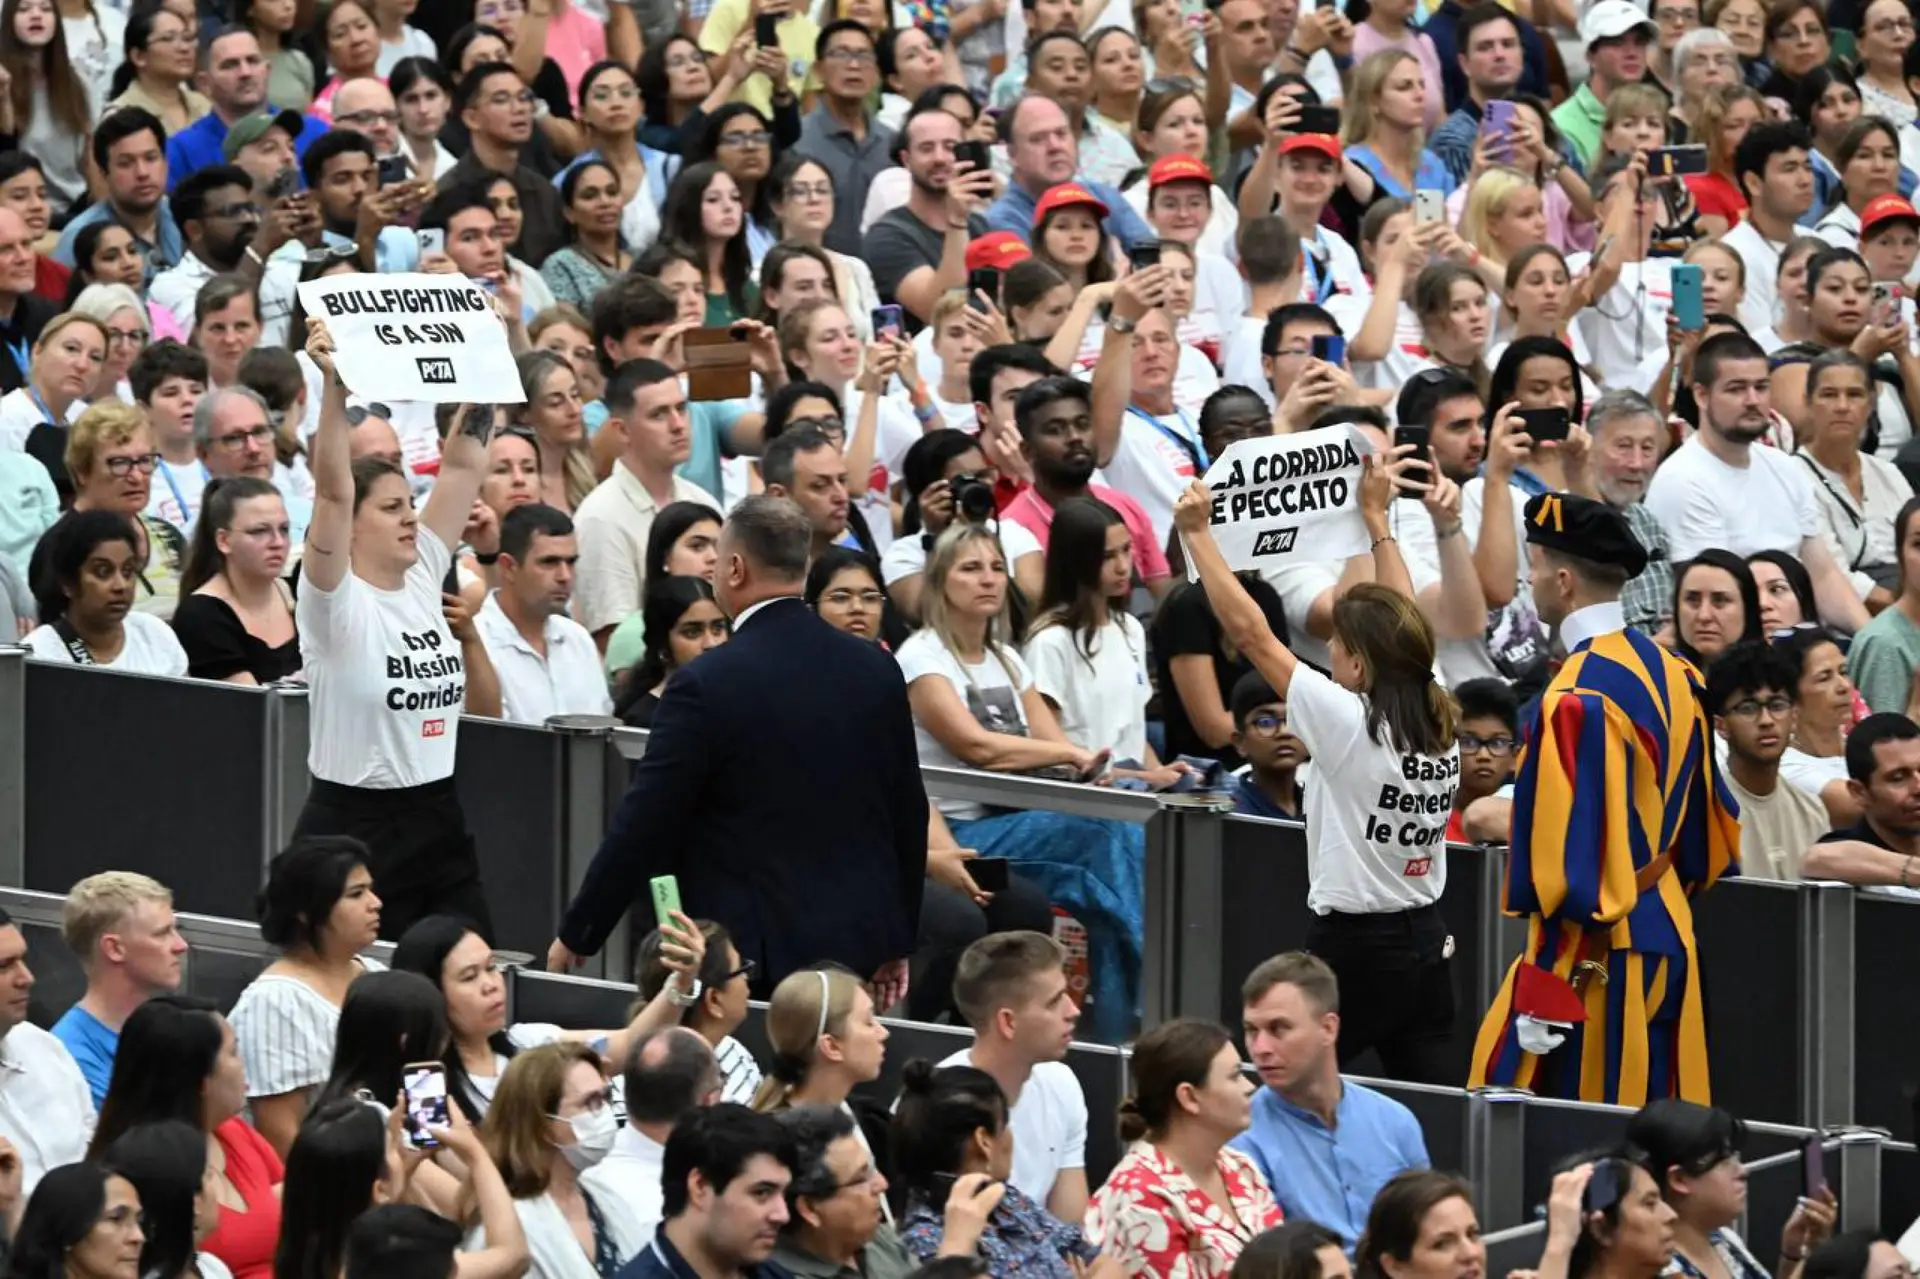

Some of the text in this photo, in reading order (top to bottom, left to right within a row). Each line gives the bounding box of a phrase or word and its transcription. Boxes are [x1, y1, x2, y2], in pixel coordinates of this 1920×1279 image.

[320, 288, 486, 316] BULLFIGHTING
[374, 322, 466, 345] IS A SIN
[1253, 438, 1360, 485] CORRIDA
[1231, 476, 1348, 523] PECCATO
[1365, 814, 1392, 844] le
